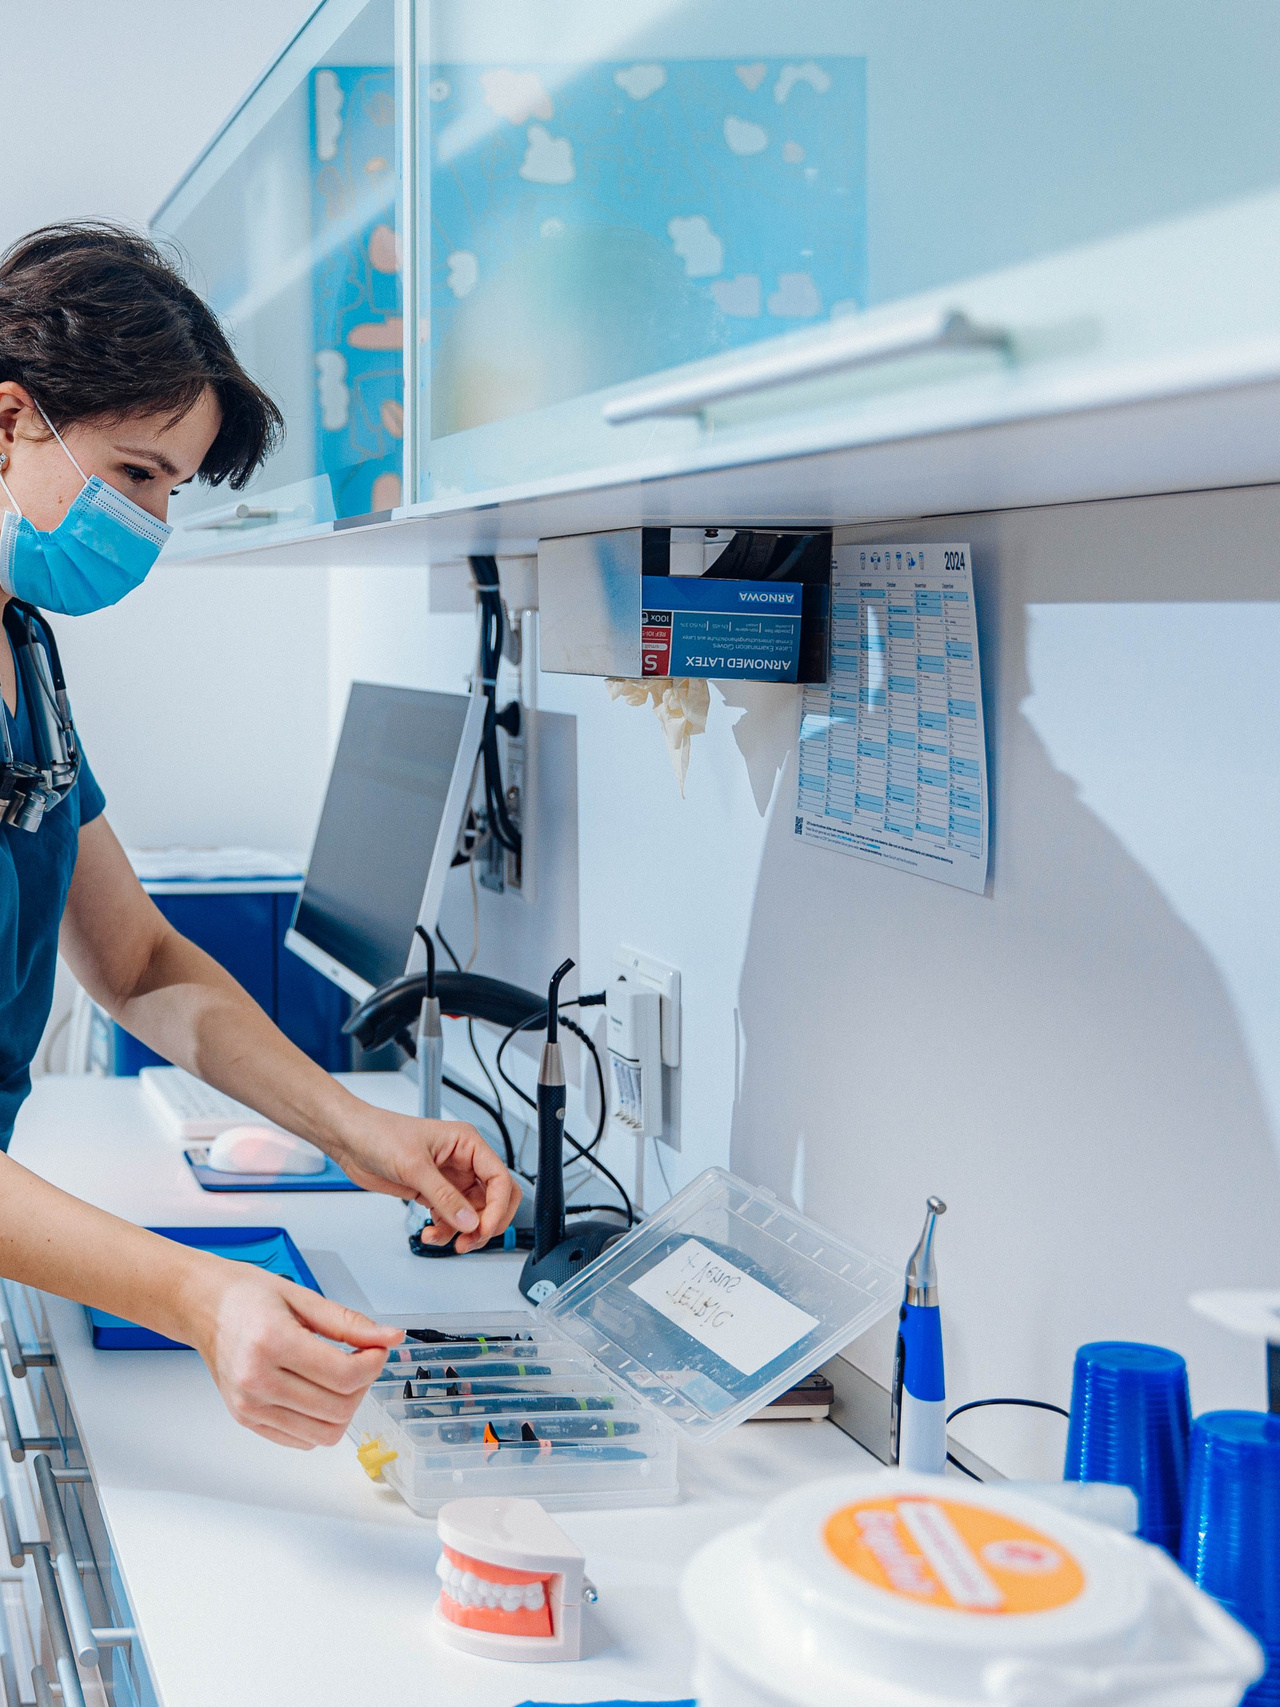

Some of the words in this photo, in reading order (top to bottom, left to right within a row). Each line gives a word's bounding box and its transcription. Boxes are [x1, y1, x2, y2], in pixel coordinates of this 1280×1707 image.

[944, 552, 966, 571] 2024
[739, 592, 794, 604] ARNOWA
[651, 614, 670, 622] 100x
[735, 644, 774, 652] Examination
[645, 654, 658, 671] S
[686, 656, 724, 667] LATEX
[727, 658, 792, 670] ARNOMED
